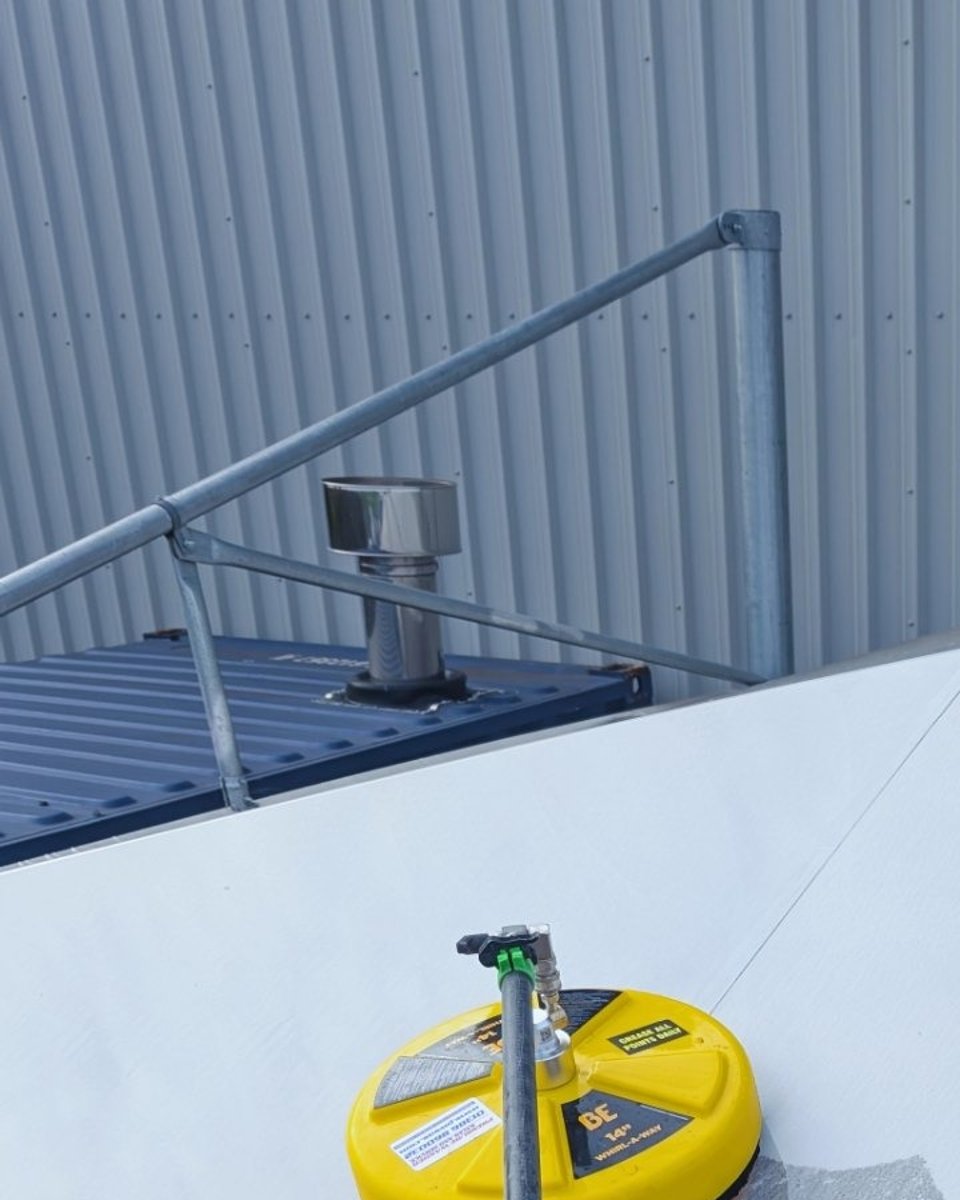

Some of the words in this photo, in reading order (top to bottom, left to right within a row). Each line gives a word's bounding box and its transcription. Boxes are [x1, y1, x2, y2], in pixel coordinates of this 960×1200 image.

[618, 1029, 655, 1045] GREASE
[654, 1023, 673, 1033] ALL
[623, 1036, 657, 1051] POINTS
[656, 1027, 682, 1040] DAILY
[578, 1103, 618, 1131] BE
[594, 1124, 662, 1161] WHIRL-A-WAY
[604, 1123, 632, 1141] 14"
